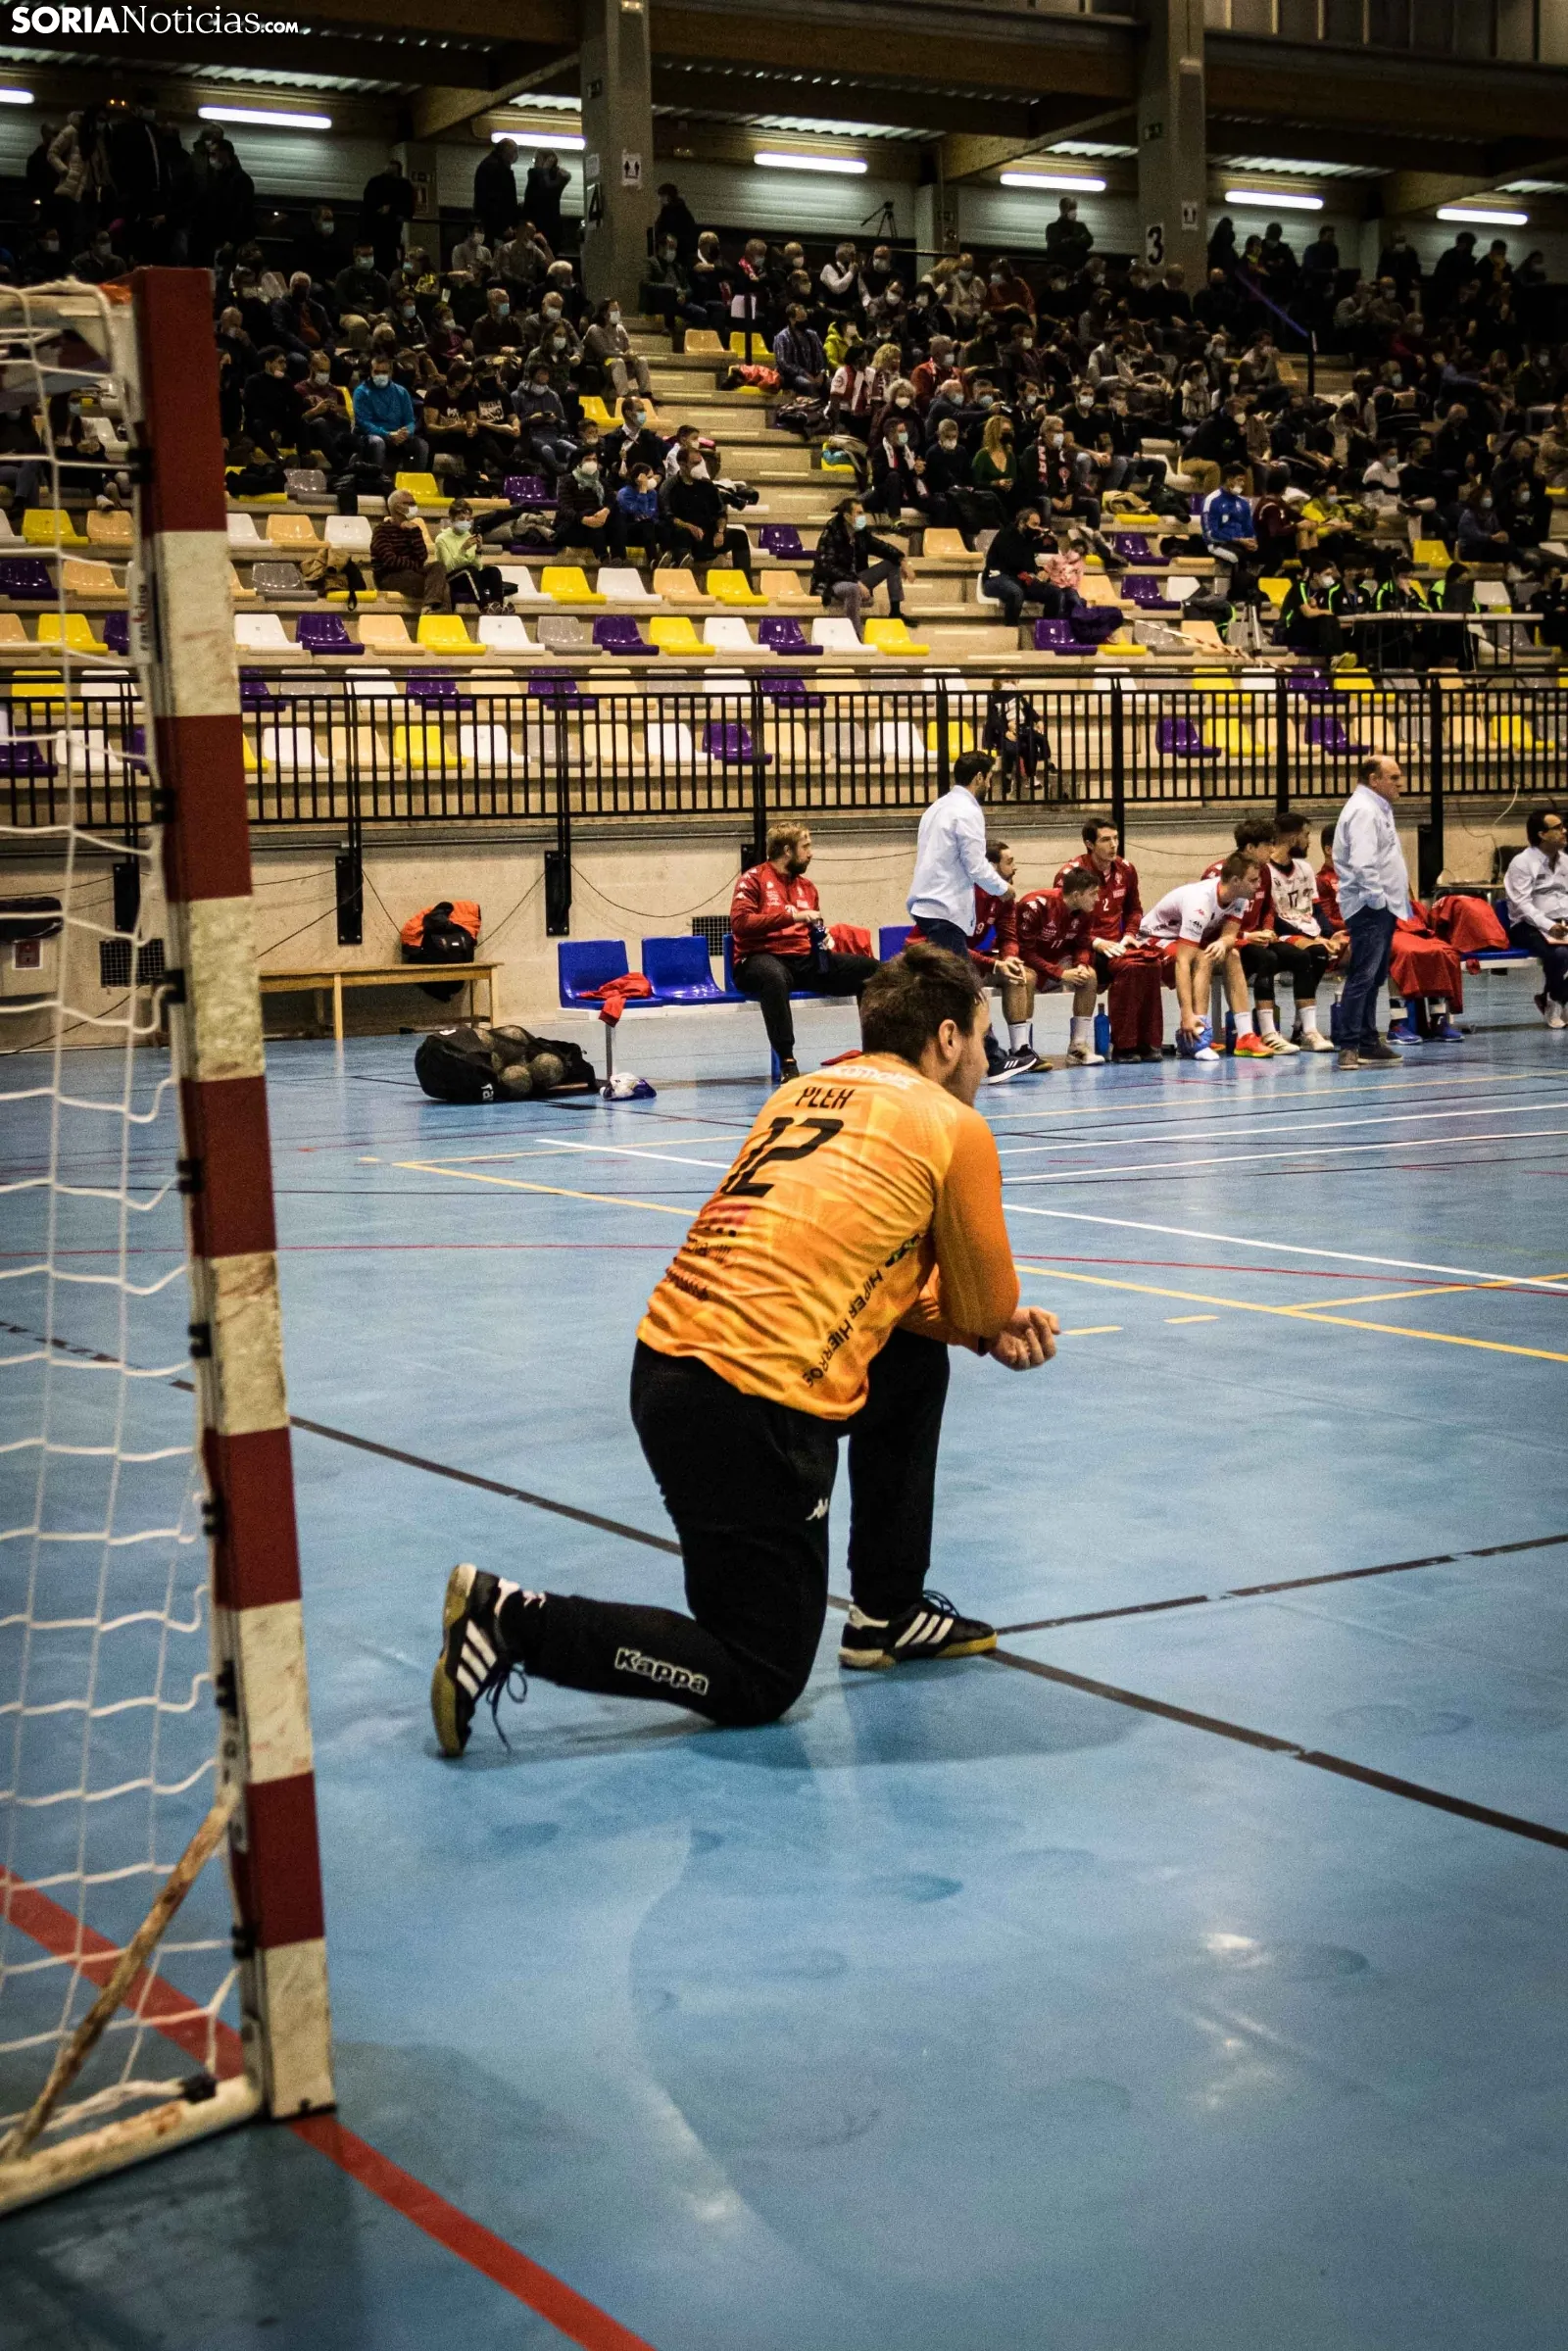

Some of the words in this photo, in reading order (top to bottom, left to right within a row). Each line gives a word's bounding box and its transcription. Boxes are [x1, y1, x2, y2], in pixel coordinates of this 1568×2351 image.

[588, 182, 604, 226] 4
[1147, 225, 1164, 266] 3
[795, 1086, 856, 1109] PLEH
[719, 1116, 845, 1198] 12
[848, 1269, 884, 1320] HIPER
[613, 1646, 710, 1696] Kappa
